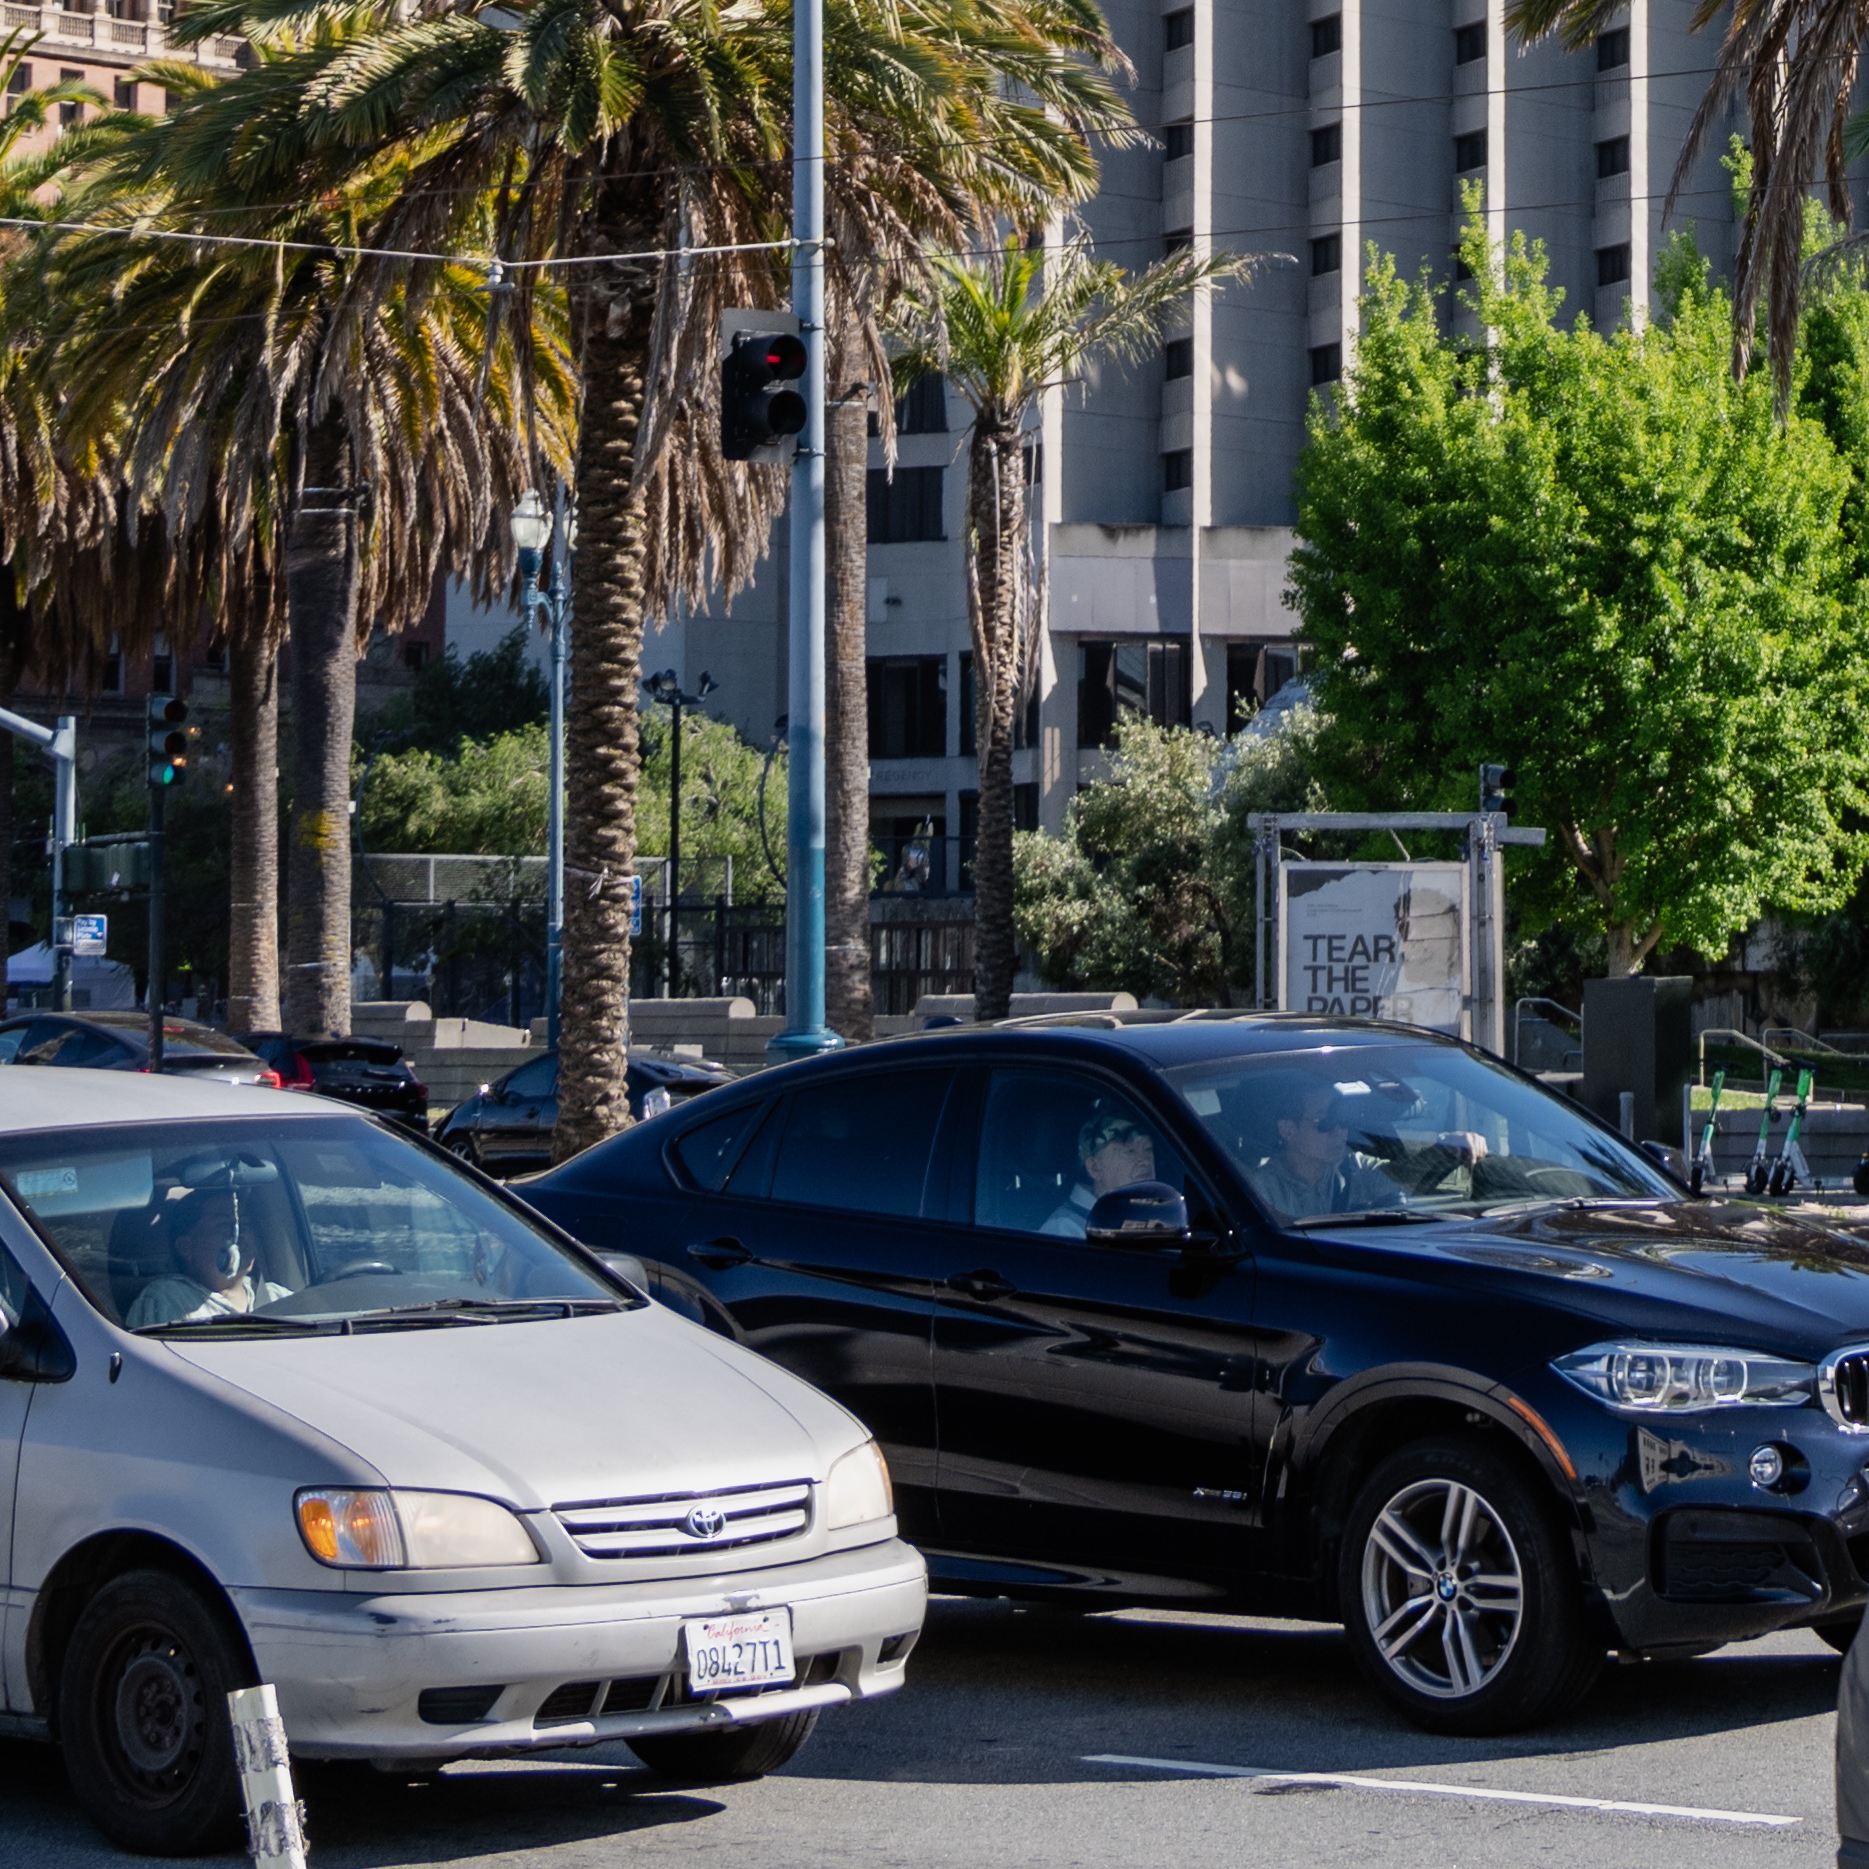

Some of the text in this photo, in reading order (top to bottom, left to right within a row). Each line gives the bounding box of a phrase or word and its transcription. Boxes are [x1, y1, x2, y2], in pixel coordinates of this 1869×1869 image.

[1303, 934, 1396, 963] TEAR
[1303, 965, 1370, 994] THE
[707, 1621, 769, 1641] California
[697, 1639, 786, 1679] 08427T1
